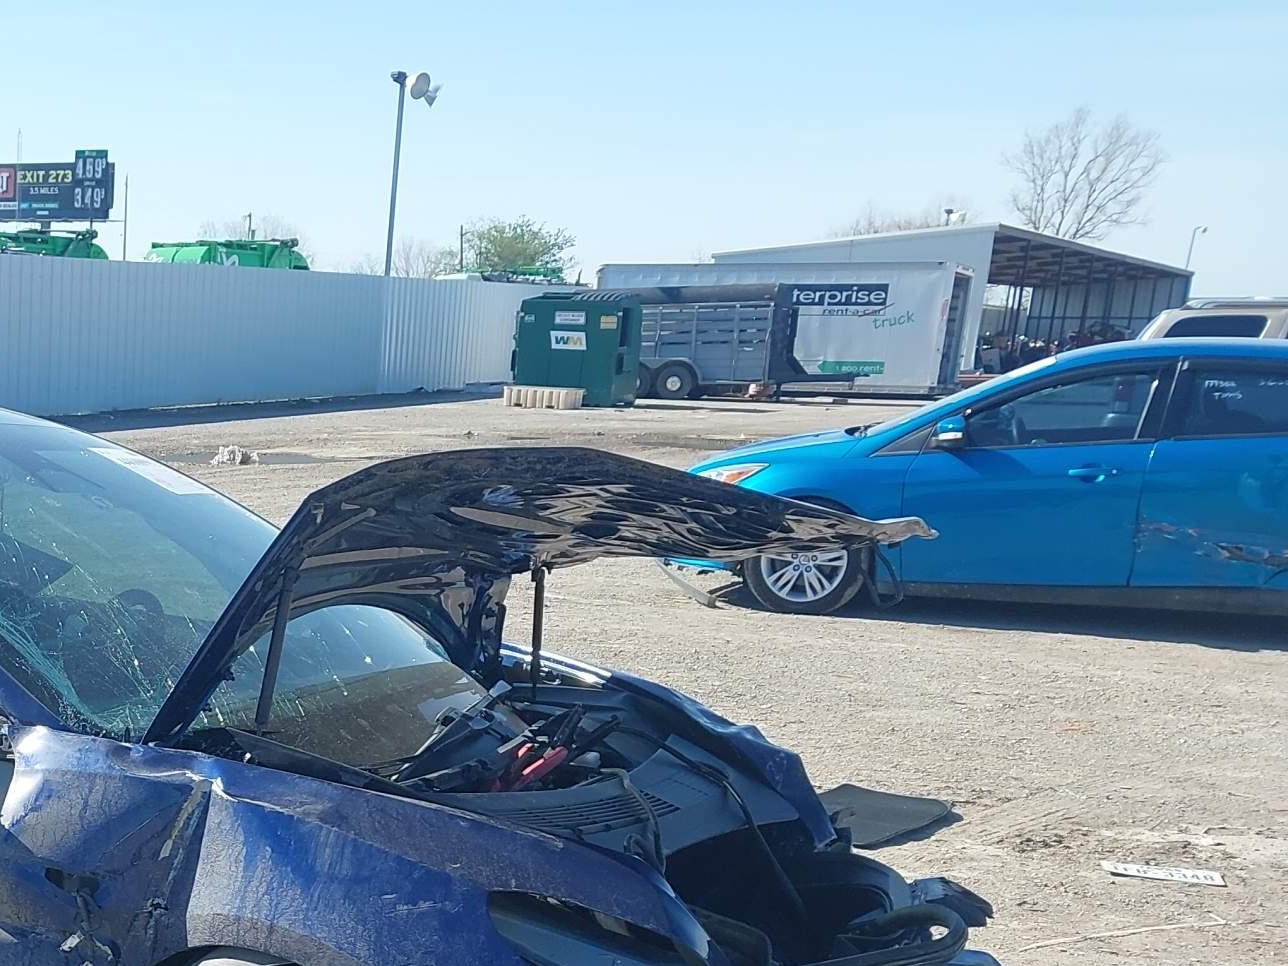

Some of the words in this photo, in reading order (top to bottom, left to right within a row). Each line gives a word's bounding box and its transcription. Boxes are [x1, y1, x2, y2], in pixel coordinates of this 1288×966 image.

[16, 170, 46, 183] EXIT
[48, 169, 72, 183] 273
[39, 186, 59, 194] MILES
[792, 286, 886, 306] terprise
[872, 310, 915, 329] truck
[554, 335, 583, 345] WM
